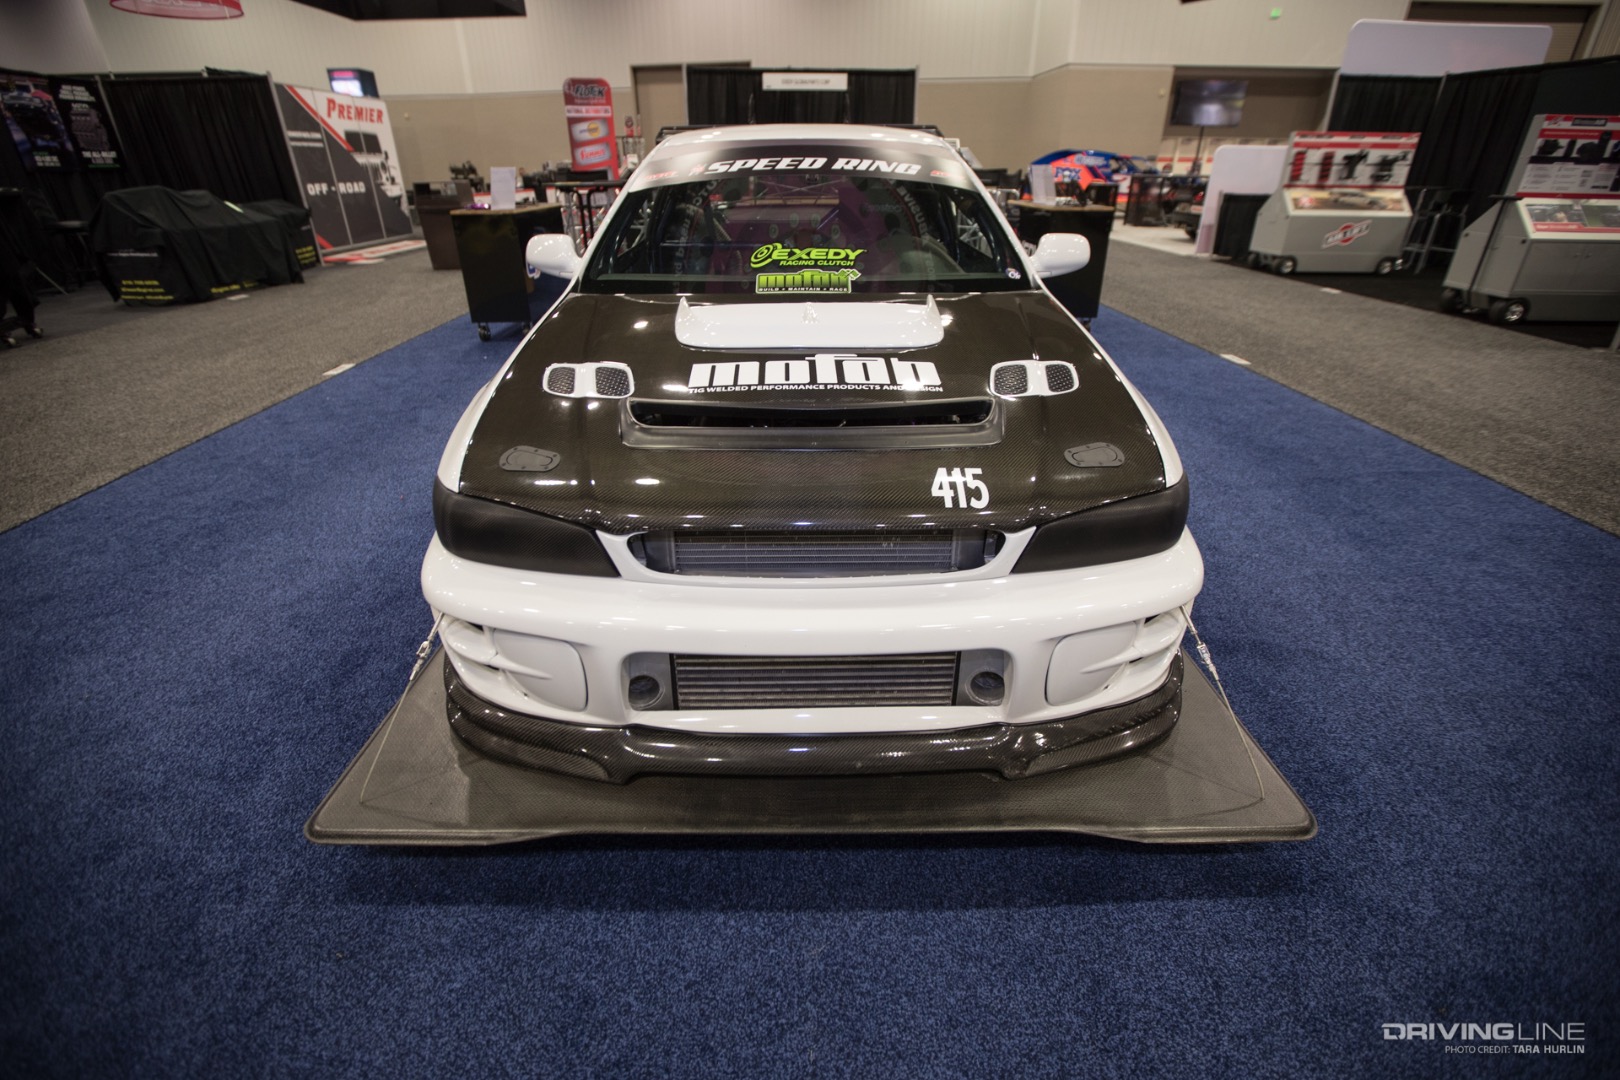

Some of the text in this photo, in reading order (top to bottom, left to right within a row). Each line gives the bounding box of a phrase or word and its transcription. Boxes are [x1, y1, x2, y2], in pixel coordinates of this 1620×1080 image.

[326, 97, 383, 123] PREMIER
[704, 157, 828, 175] SPEED
[831, 157, 921, 175] RING
[306, 183, 328, 195] OFF
[339, 182, 366, 193] ROAD
[772, 248, 864, 260] EXEDY
[706, 385, 749, 393] WELDED
[931, 467, 990, 509] 415
